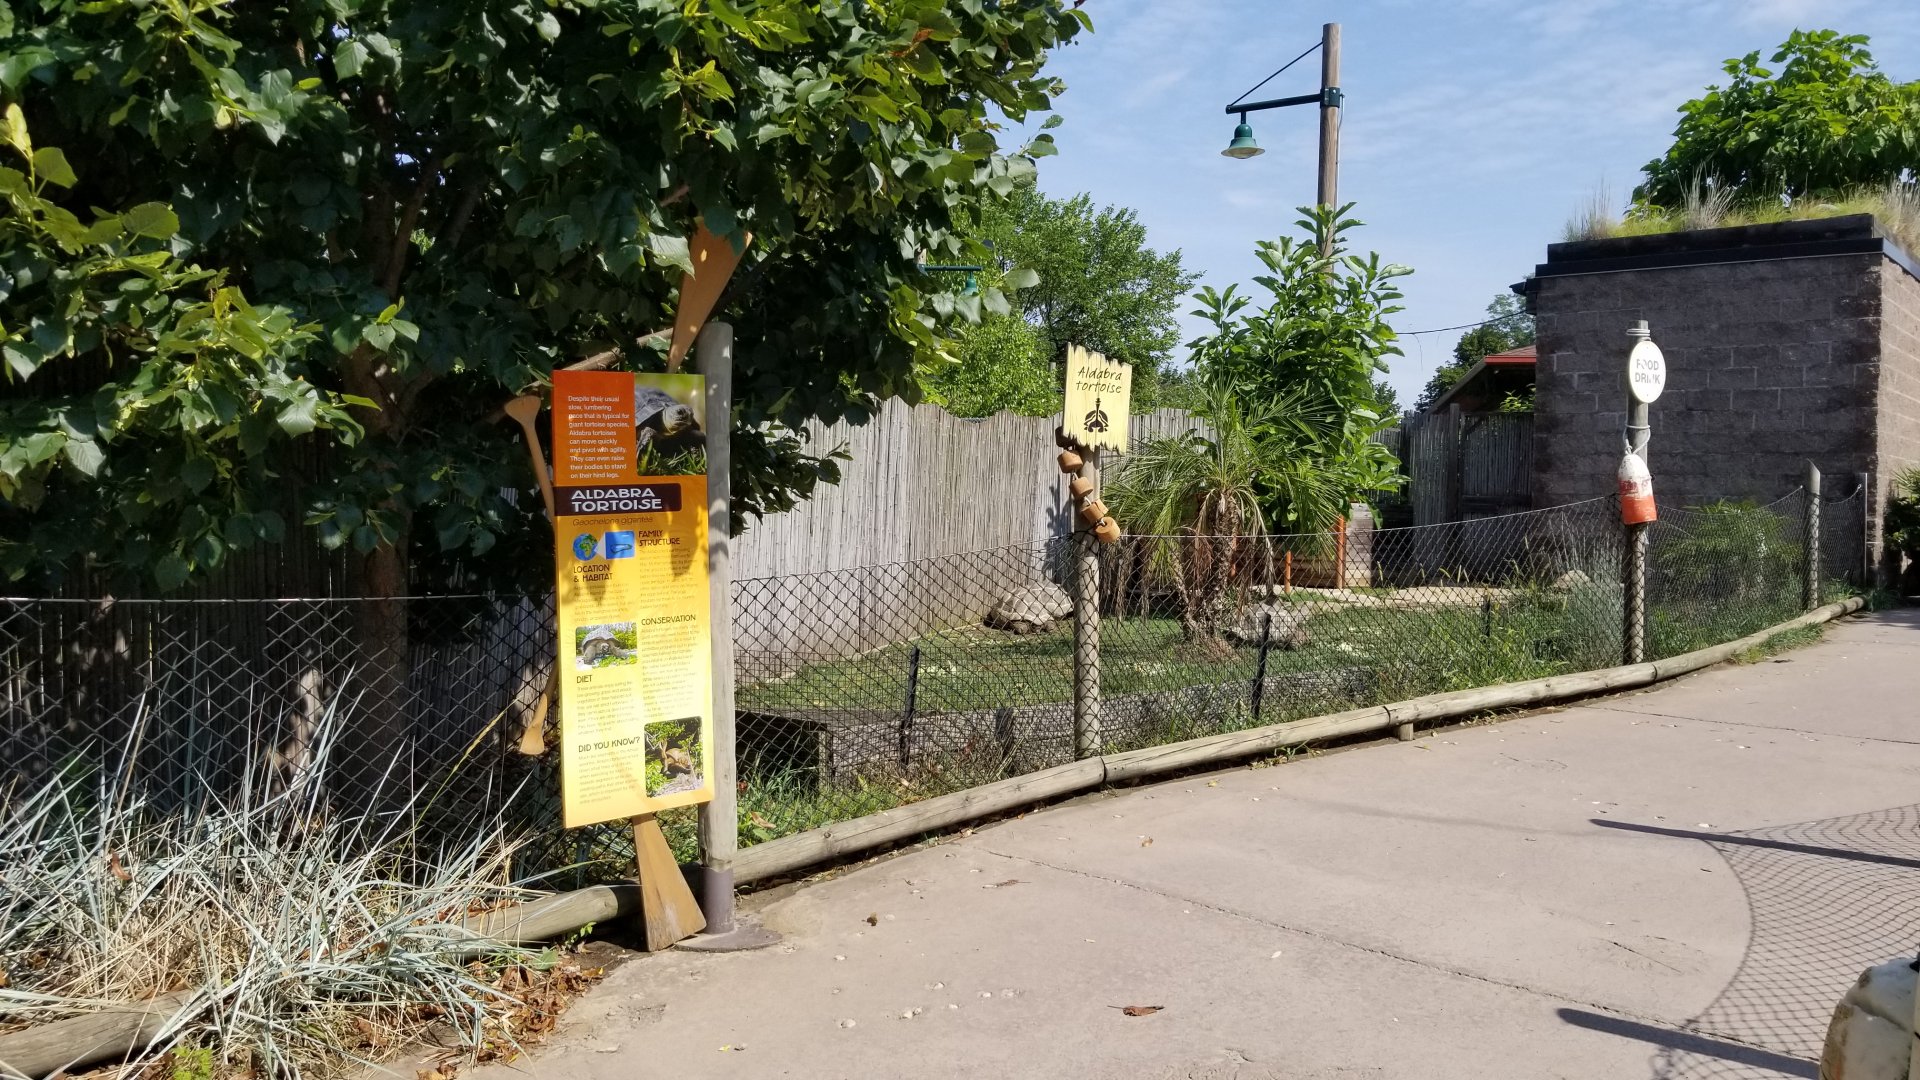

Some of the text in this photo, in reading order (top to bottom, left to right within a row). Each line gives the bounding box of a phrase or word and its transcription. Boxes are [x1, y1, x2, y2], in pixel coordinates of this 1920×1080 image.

[1077, 366, 1122, 380] Aldabra
[1076, 381, 1122, 393] tortoise
[570, 455, 584, 463] They
[571, 488, 656, 500] ALDABRA
[571, 498, 663, 512] TORTOISE
[638, 529, 663, 538] FAMILY
[639, 537, 681, 547] STRUCTURE
[573, 564, 610, 574] LOCATION
[573, 573, 613, 583] & HABITAT
[641, 614, 697, 626] CONSERVATION
[576, 674, 593, 684] DIET
[578, 736, 641, 753] DID YOU KNOW?
